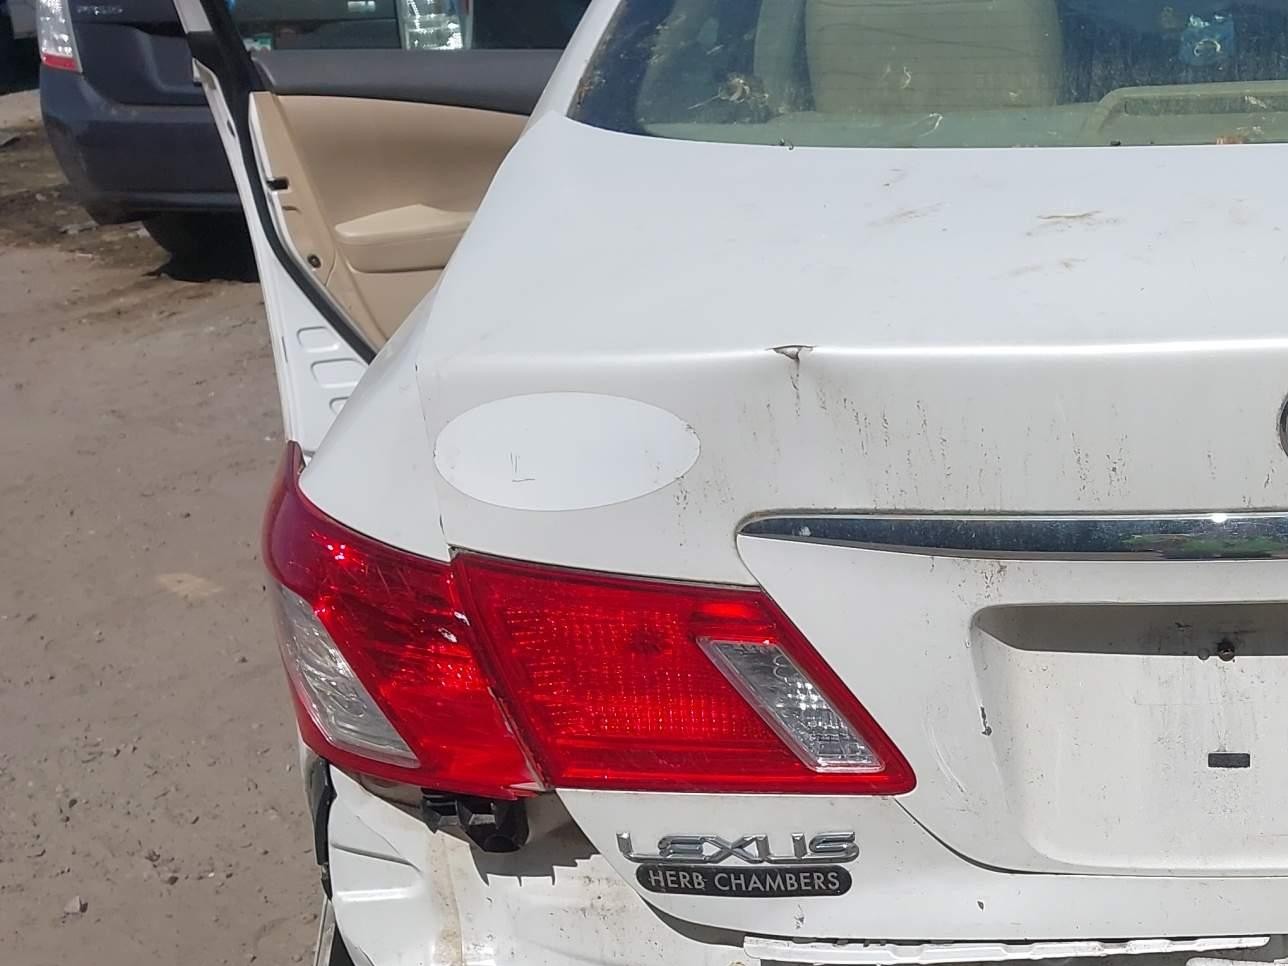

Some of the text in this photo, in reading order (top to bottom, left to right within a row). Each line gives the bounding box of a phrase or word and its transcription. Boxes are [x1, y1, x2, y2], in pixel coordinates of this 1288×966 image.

[615, 830, 860, 865] LEXUS
[648, 869, 841, 892] HERB CHAMBERS
